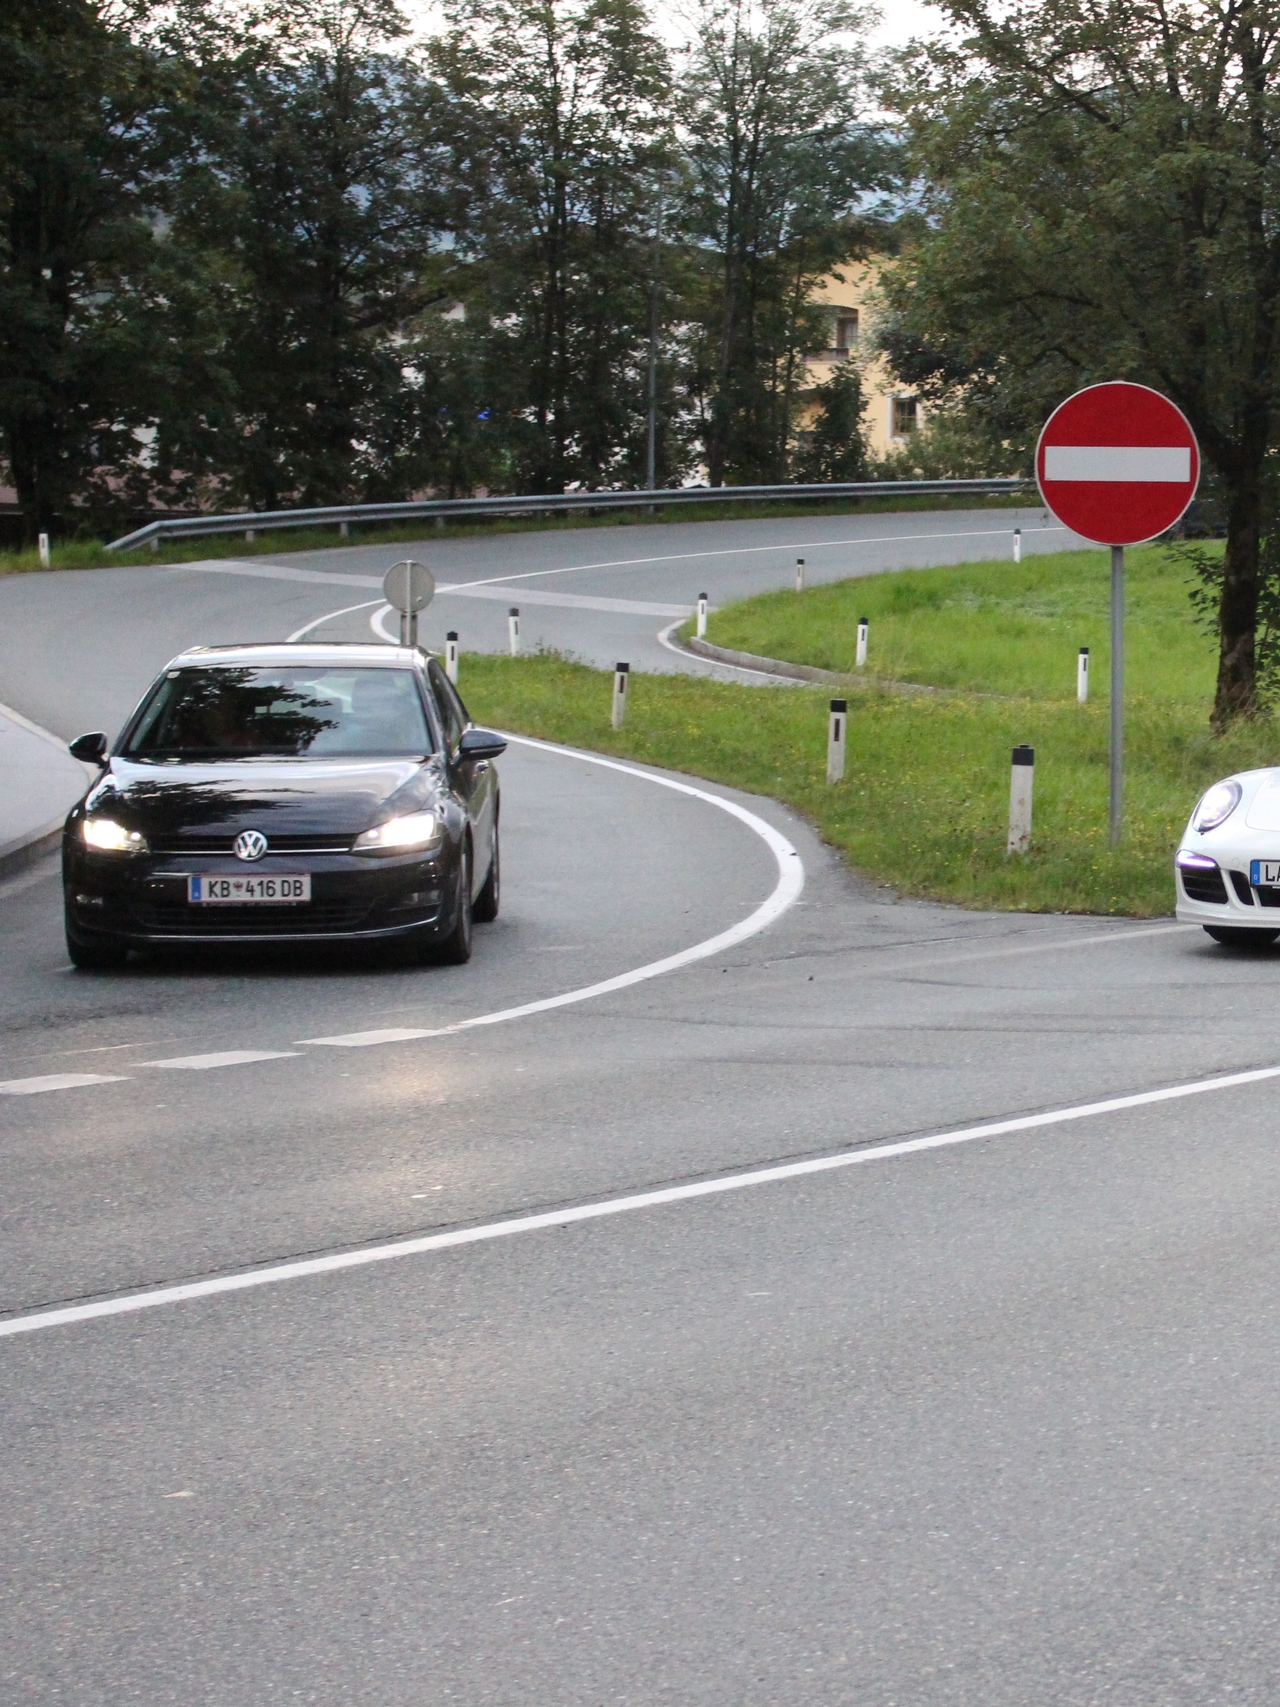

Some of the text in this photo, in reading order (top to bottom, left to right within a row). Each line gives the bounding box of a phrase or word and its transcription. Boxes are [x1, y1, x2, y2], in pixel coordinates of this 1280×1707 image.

[236, 831, 266, 860] VW
[208, 880, 304, 898] KB 416 DB
